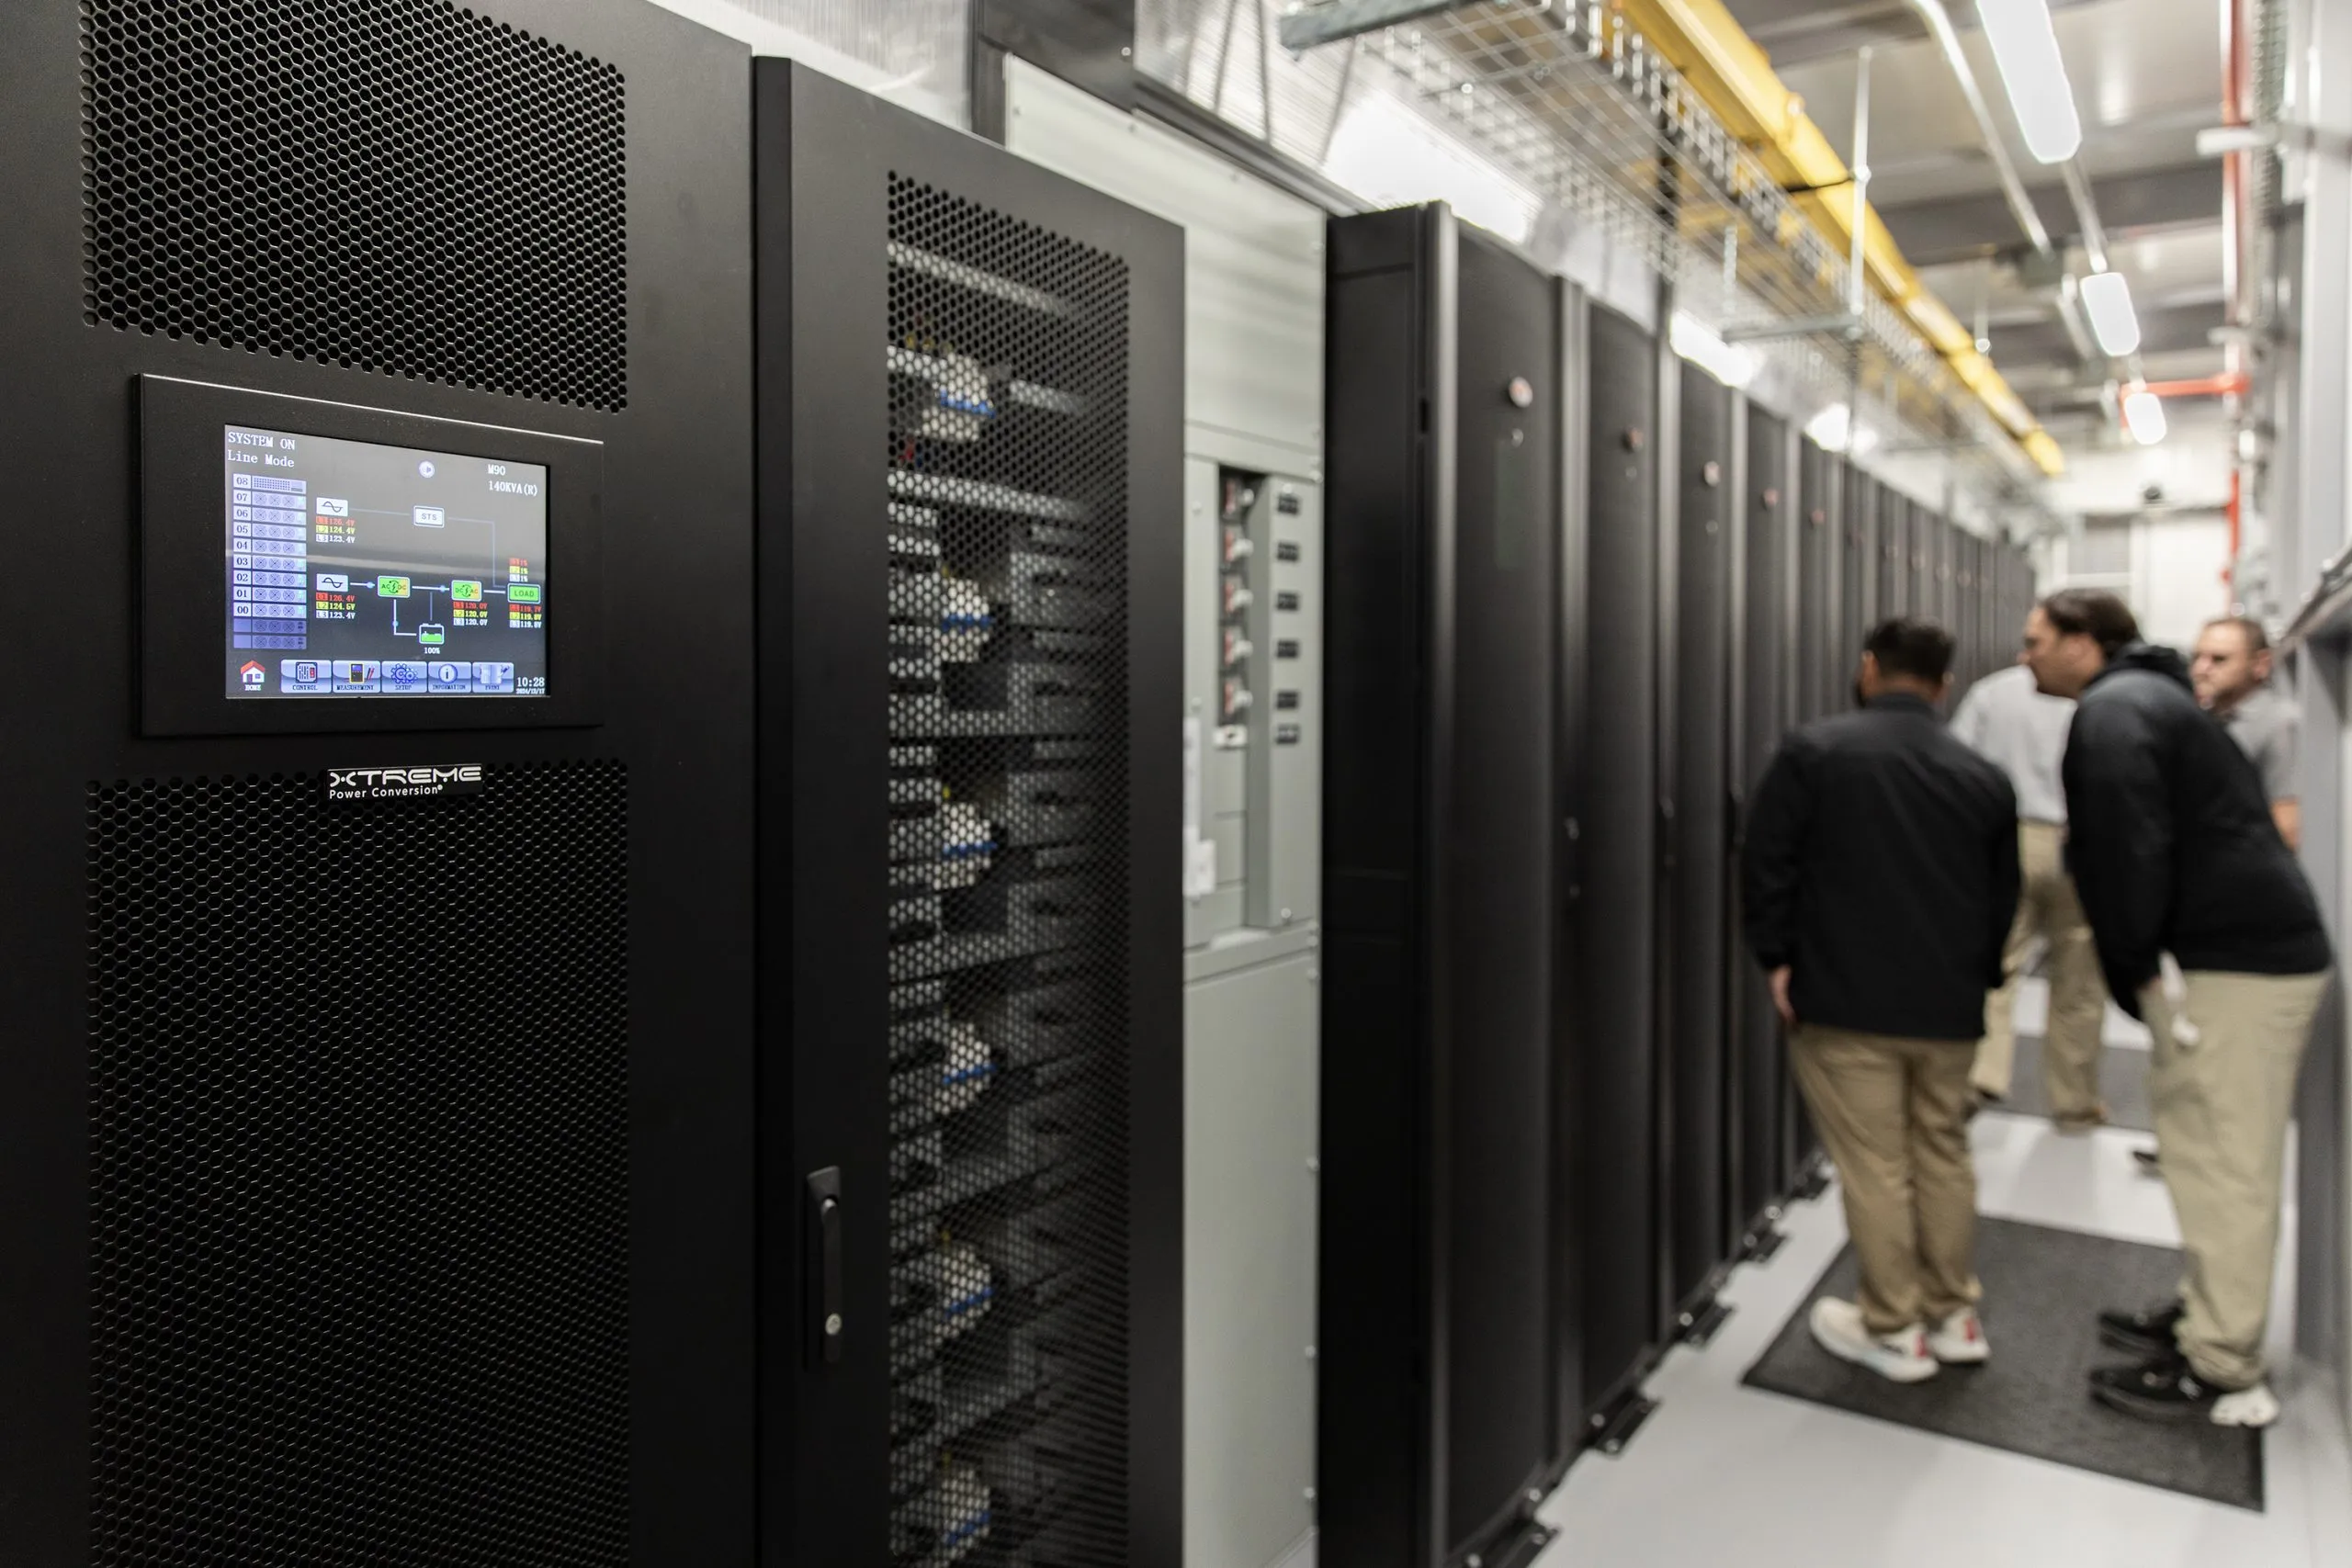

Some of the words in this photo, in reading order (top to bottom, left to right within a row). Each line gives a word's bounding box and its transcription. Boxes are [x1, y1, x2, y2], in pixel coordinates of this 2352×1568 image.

[228, 432, 274, 447] SYSTEM
[280, 438, 296, 450] ON
[228, 449, 258, 464] Line
[265, 454, 295, 468] Mode
[488, 464, 506, 476] M90
[236, 477, 248, 486] 08
[489, 480, 538, 497] 140KVA(R)
[236, 492, 248, 502] 07
[236, 508, 248, 518] 06
[421, 513, 437, 521] STS
[236, 525, 248, 534] 05
[236, 541, 248, 550] 04
[236, 557, 248, 566] 03
[236, 573, 248, 581] 02
[236, 589, 248, 598] 01
[237, 605, 249, 615] 00
[424, 647, 441, 655] 100%
[517, 677, 545, 687] 10:28
[330, 766, 481, 787] XTREME
[330, 789, 367, 799] Power
